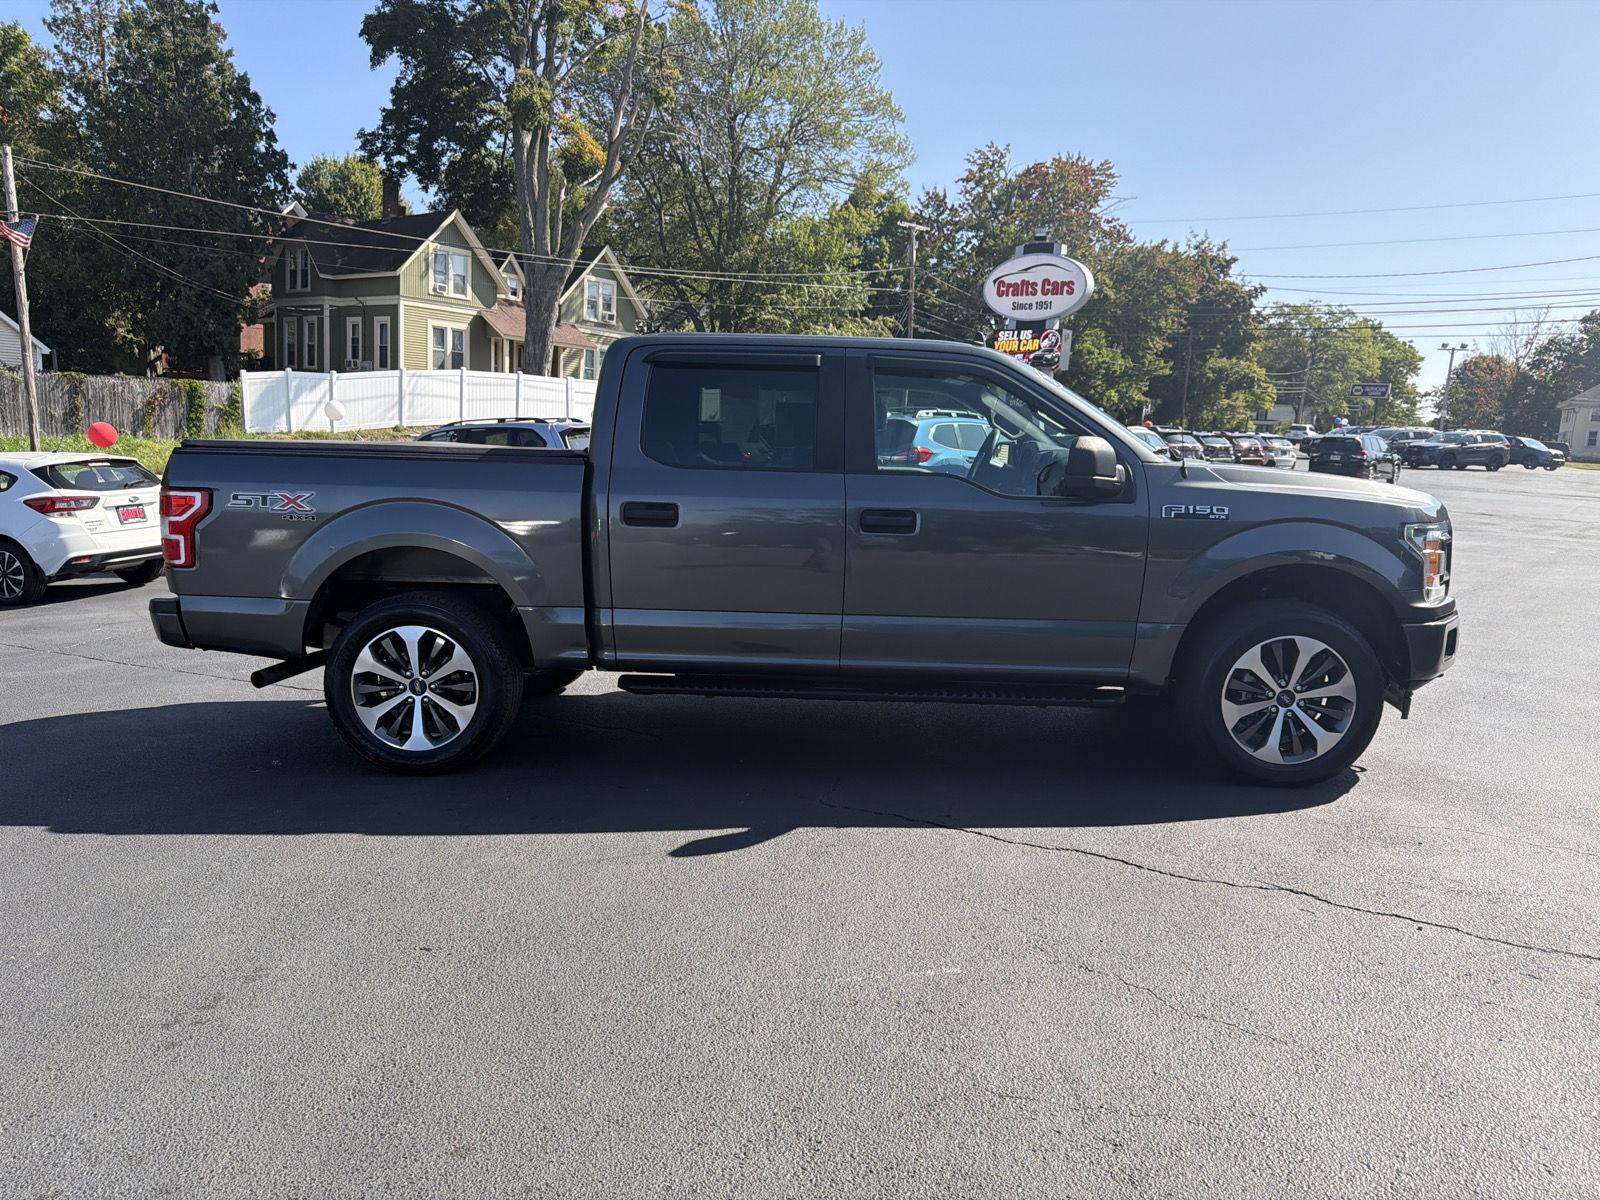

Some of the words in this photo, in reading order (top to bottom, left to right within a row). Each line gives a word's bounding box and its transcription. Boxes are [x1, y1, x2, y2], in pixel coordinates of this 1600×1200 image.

[996, 279, 1038, 297] Crafts
[1040, 278, 1075, 296] Cars
[1011, 302, 1033, 311] Since
[1035, 300, 1053, 310] 1951
[998, 330, 1019, 341] SELL
[1020, 330, 1032, 340] US
[994, 340, 1019, 351] YOUR
[1020, 339, 1040, 351] CAR
[226, 491, 315, 513] STX
